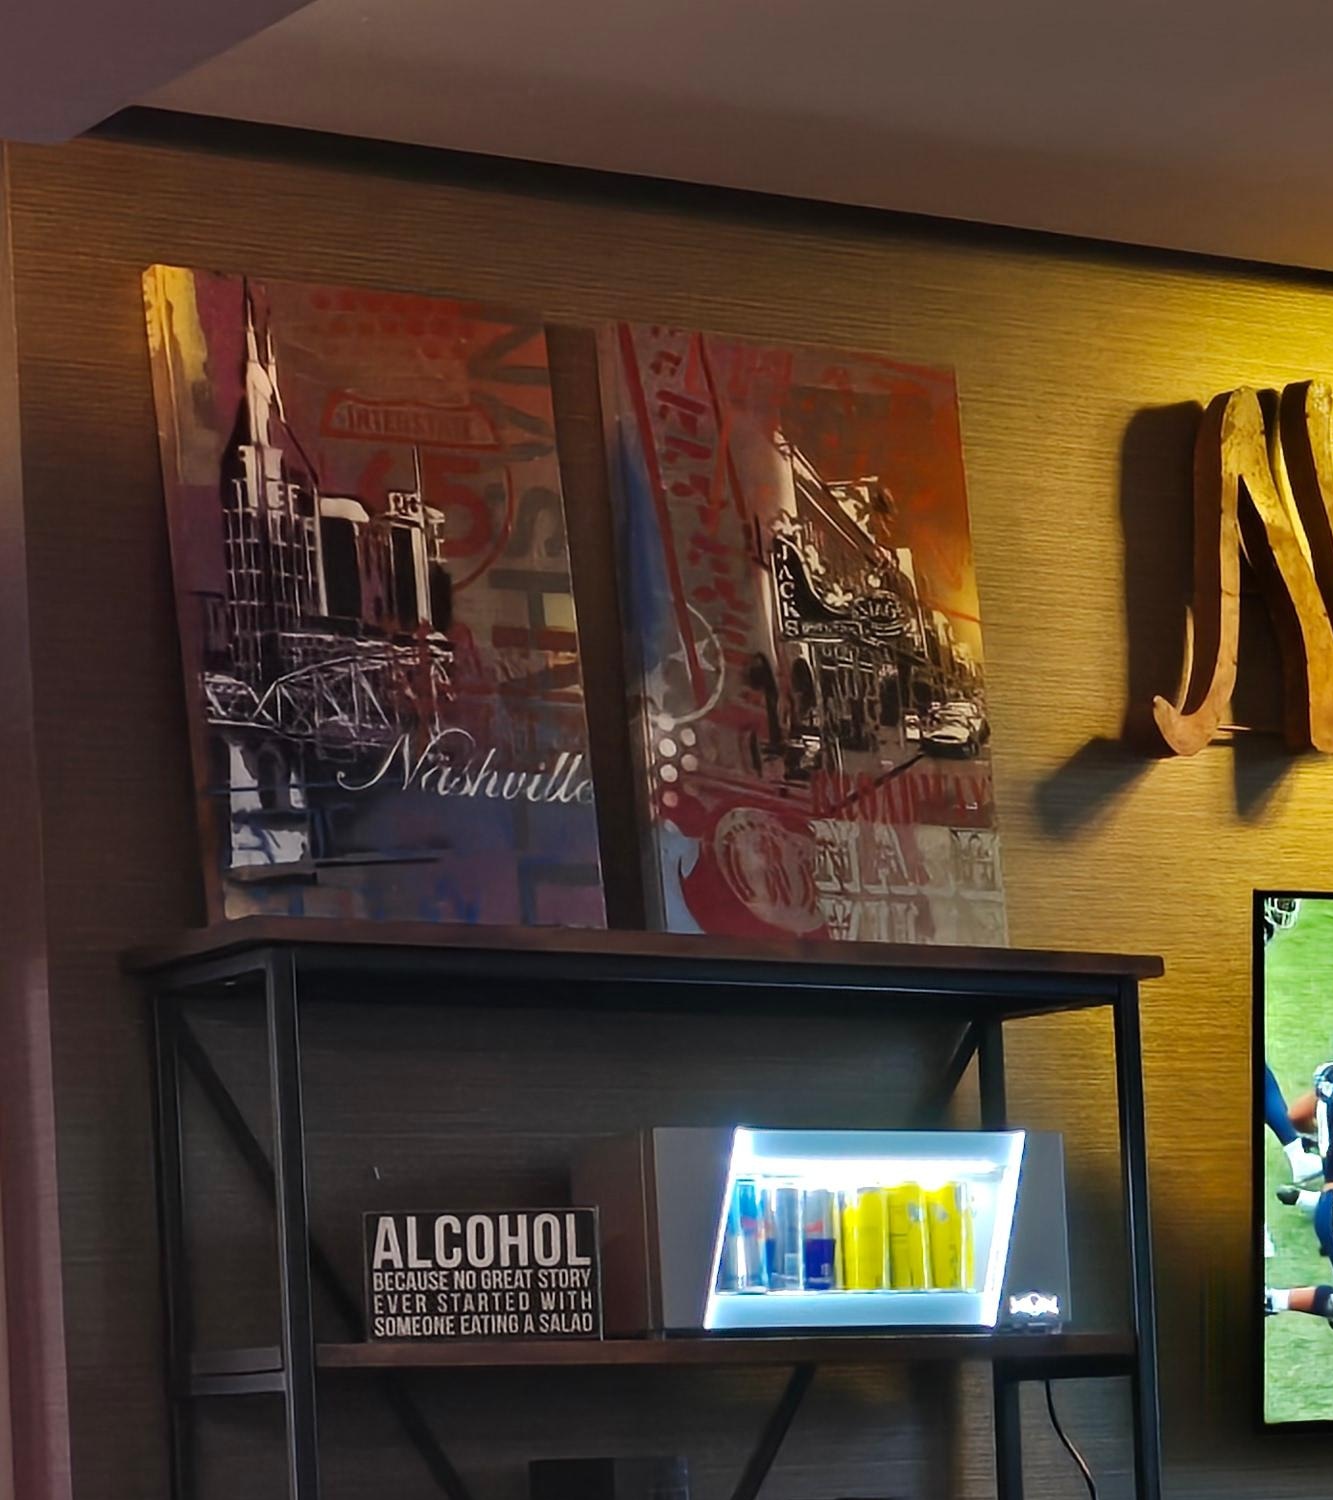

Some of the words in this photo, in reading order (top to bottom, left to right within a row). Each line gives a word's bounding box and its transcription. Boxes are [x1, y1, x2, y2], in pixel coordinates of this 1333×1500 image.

[337, 728, 595, 804] Nashville
[372, 1213, 592, 1269] ALCOHOL
[373, 1271, 449, 1292] BECAUSE
[453, 1270, 477, 1290] NO
[481, 1269, 533, 1290] GREAT
[538, 1268, 592, 1289] STORY
[374, 1294, 427, 1315] EVER
[437, 1291, 530, 1313] STARTED
[540, 1291, 592, 1312] WITH
[374, 1315, 455, 1337] SOMEONE
[460, 1314, 519, 1335] EATING
[523, 1314, 535, 1333] A
[539, 1313, 593, 1333] SALAD
